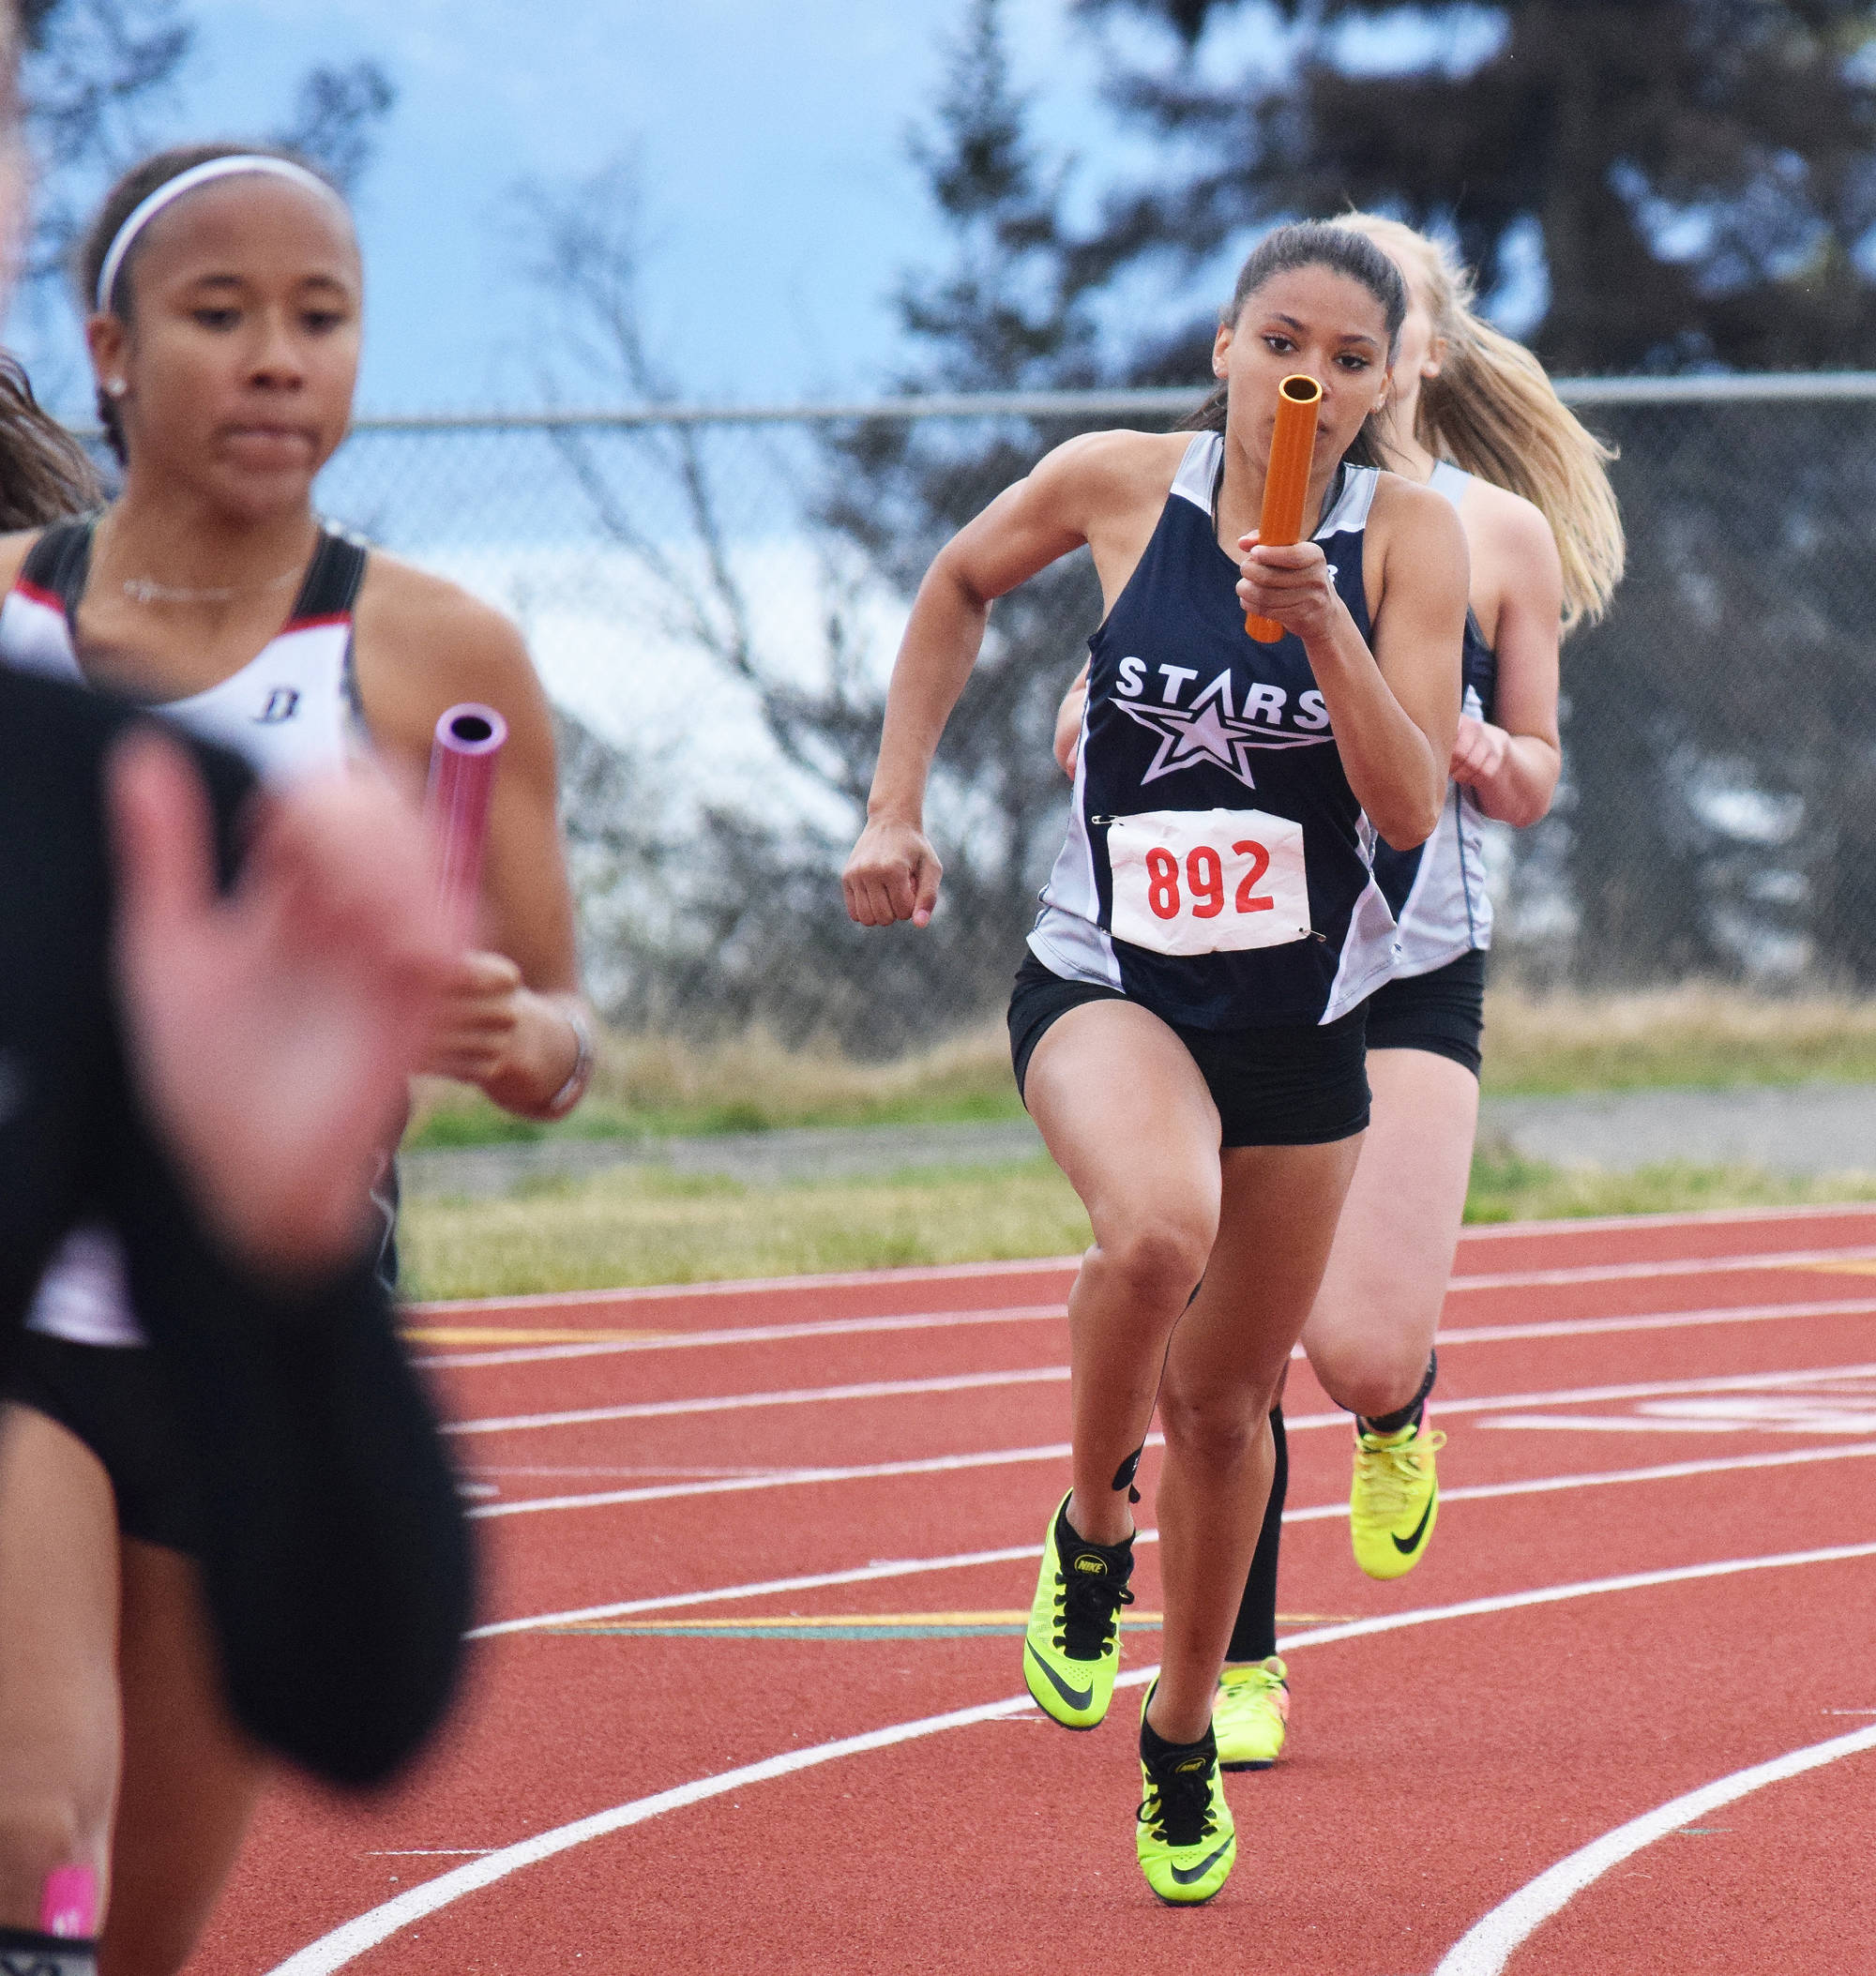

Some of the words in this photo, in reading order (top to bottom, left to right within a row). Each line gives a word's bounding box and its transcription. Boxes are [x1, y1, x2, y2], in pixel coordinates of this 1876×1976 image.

[1115, 656, 1330, 730] STARS
[1145, 839, 1274, 919] 892
[1078, 1560, 1103, 1573] NIKE
